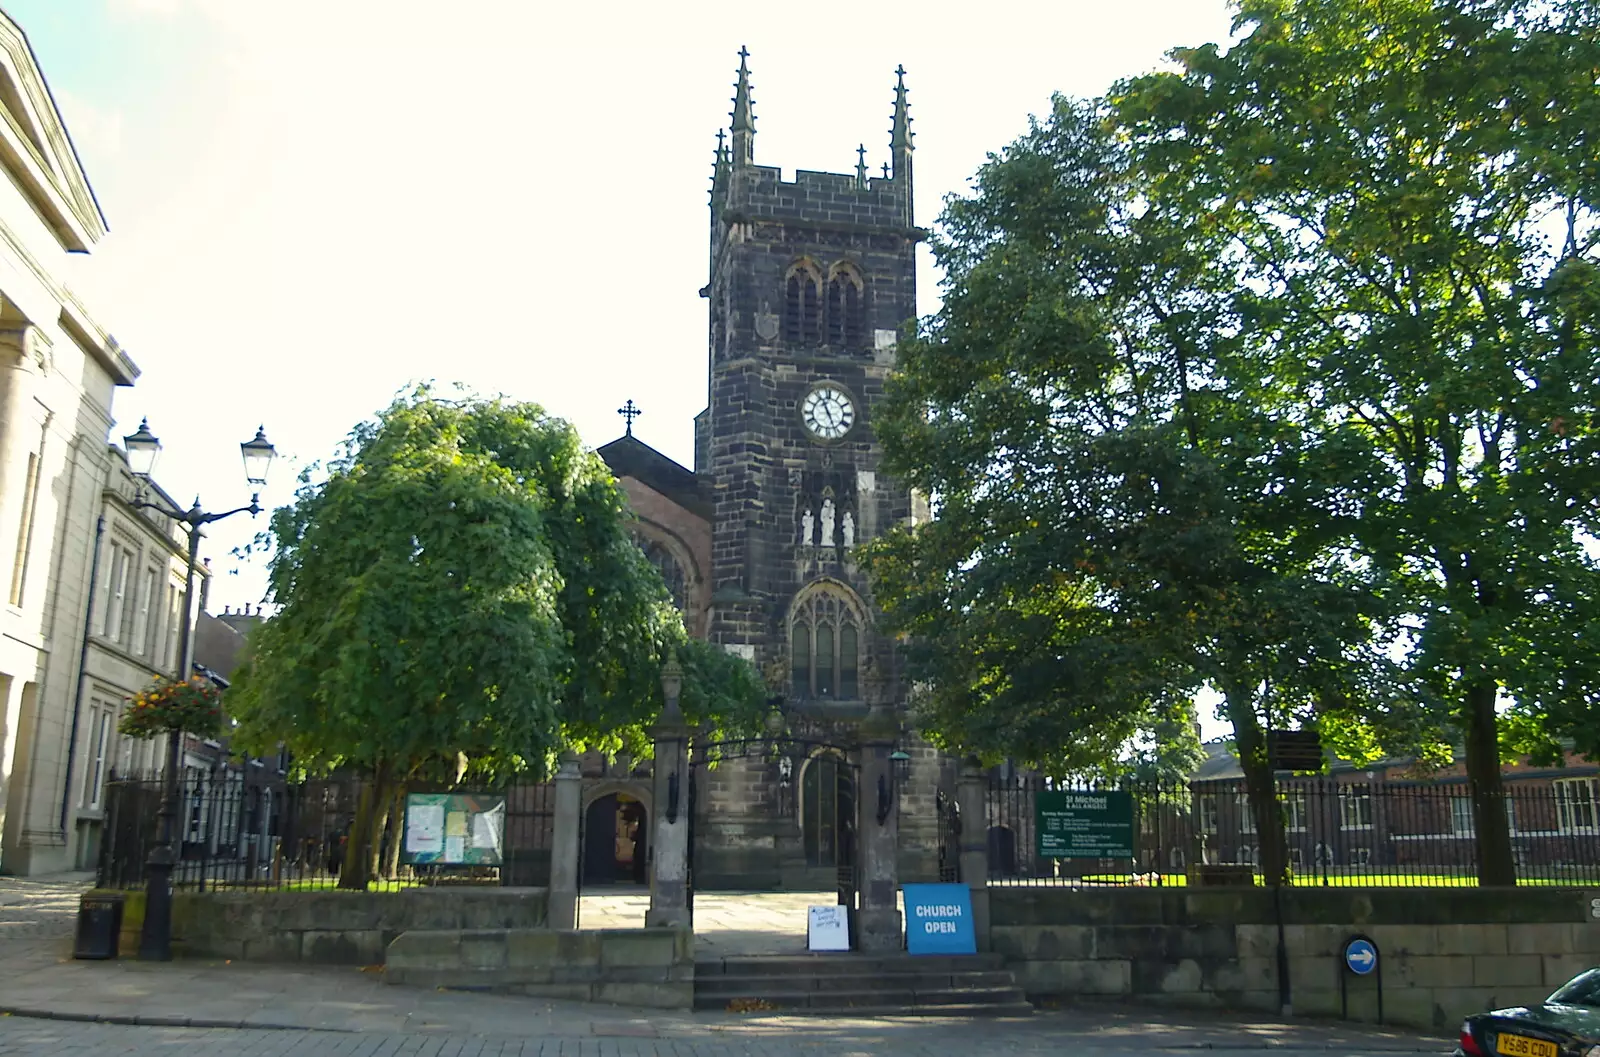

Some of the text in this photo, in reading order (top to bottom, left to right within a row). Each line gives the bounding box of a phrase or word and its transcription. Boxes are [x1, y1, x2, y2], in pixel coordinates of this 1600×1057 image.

[1075, 796, 1107, 804] Michael
[916, 905, 962, 917] CHURCH
[925, 921, 956, 933] OPEN
[1531, 1042, 1553, 1057] CDU
